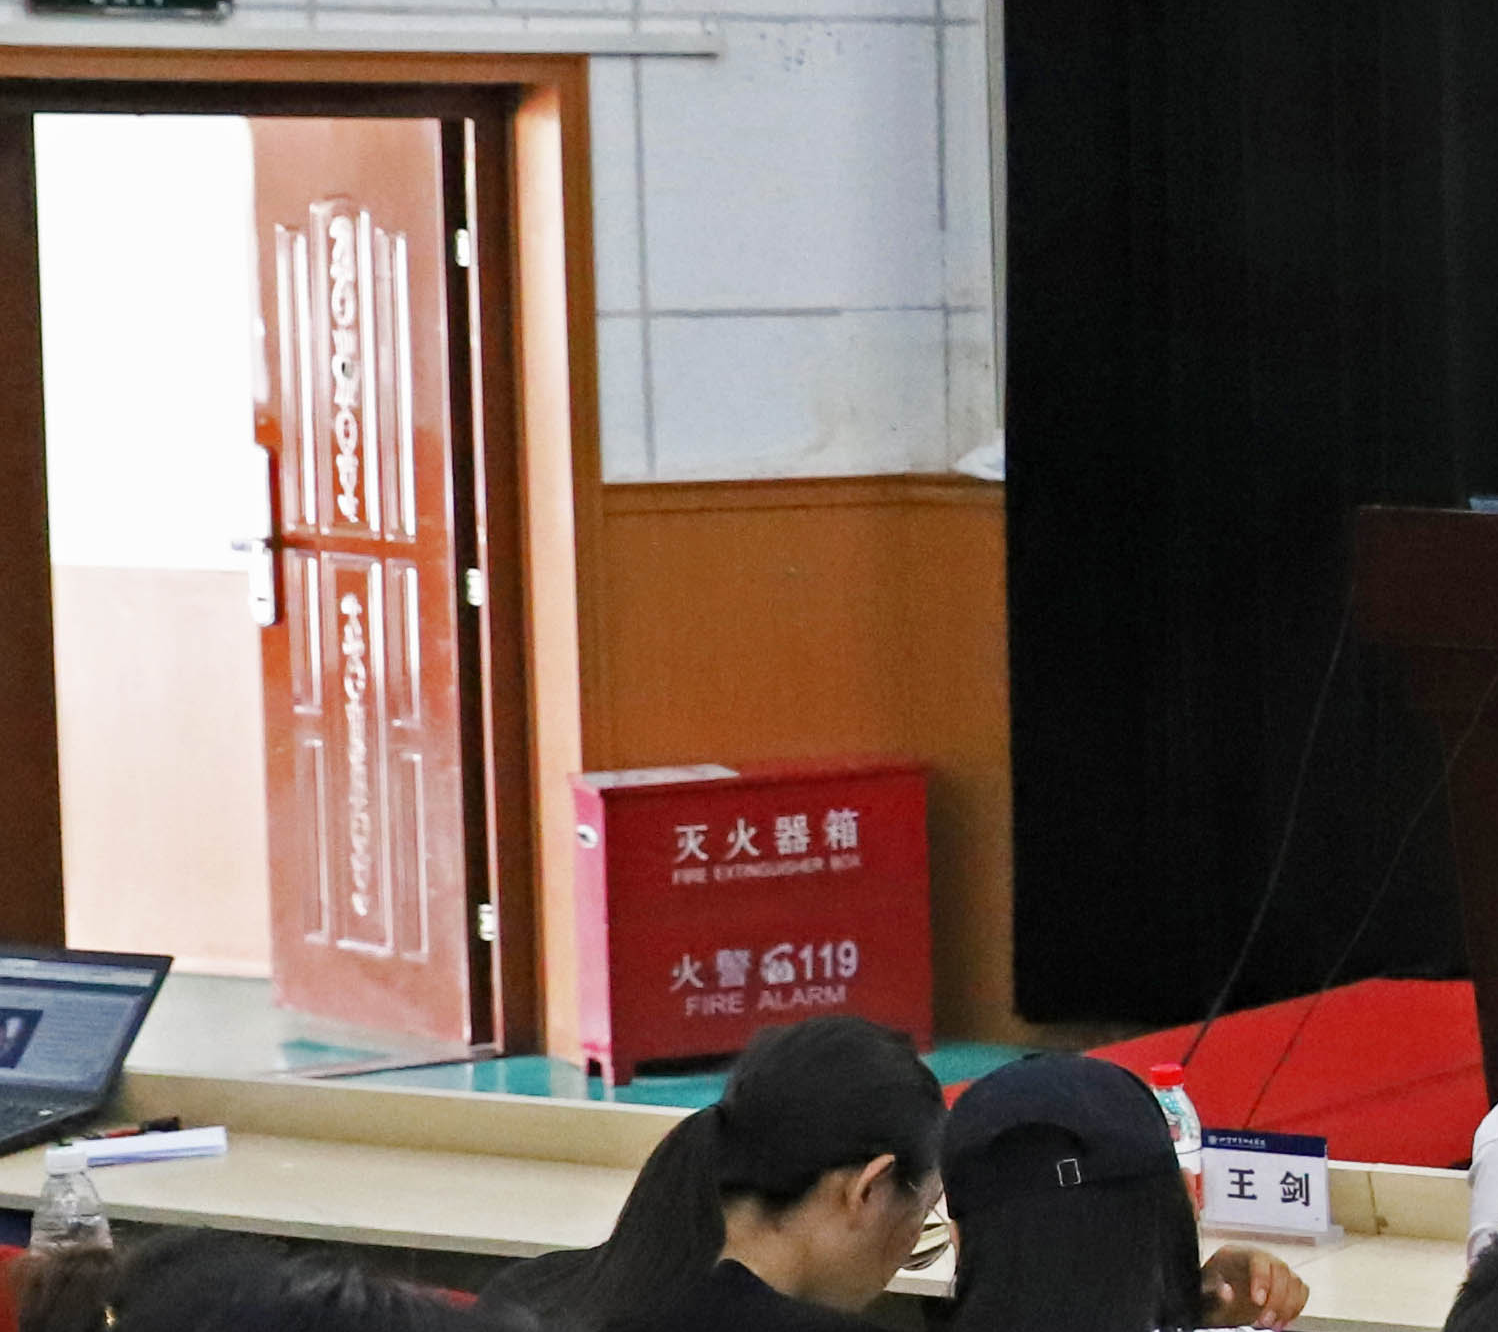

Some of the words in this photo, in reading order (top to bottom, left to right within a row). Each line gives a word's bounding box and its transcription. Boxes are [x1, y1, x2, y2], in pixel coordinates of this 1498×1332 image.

[674, 807, 860, 864] 灭火器箱
[798, 939, 860, 981] 119
[685, 991, 746, 1017] FIRE
[757, 983, 848, 1011] ALARM
[1227, 1168, 1310, 1207] 王剑
